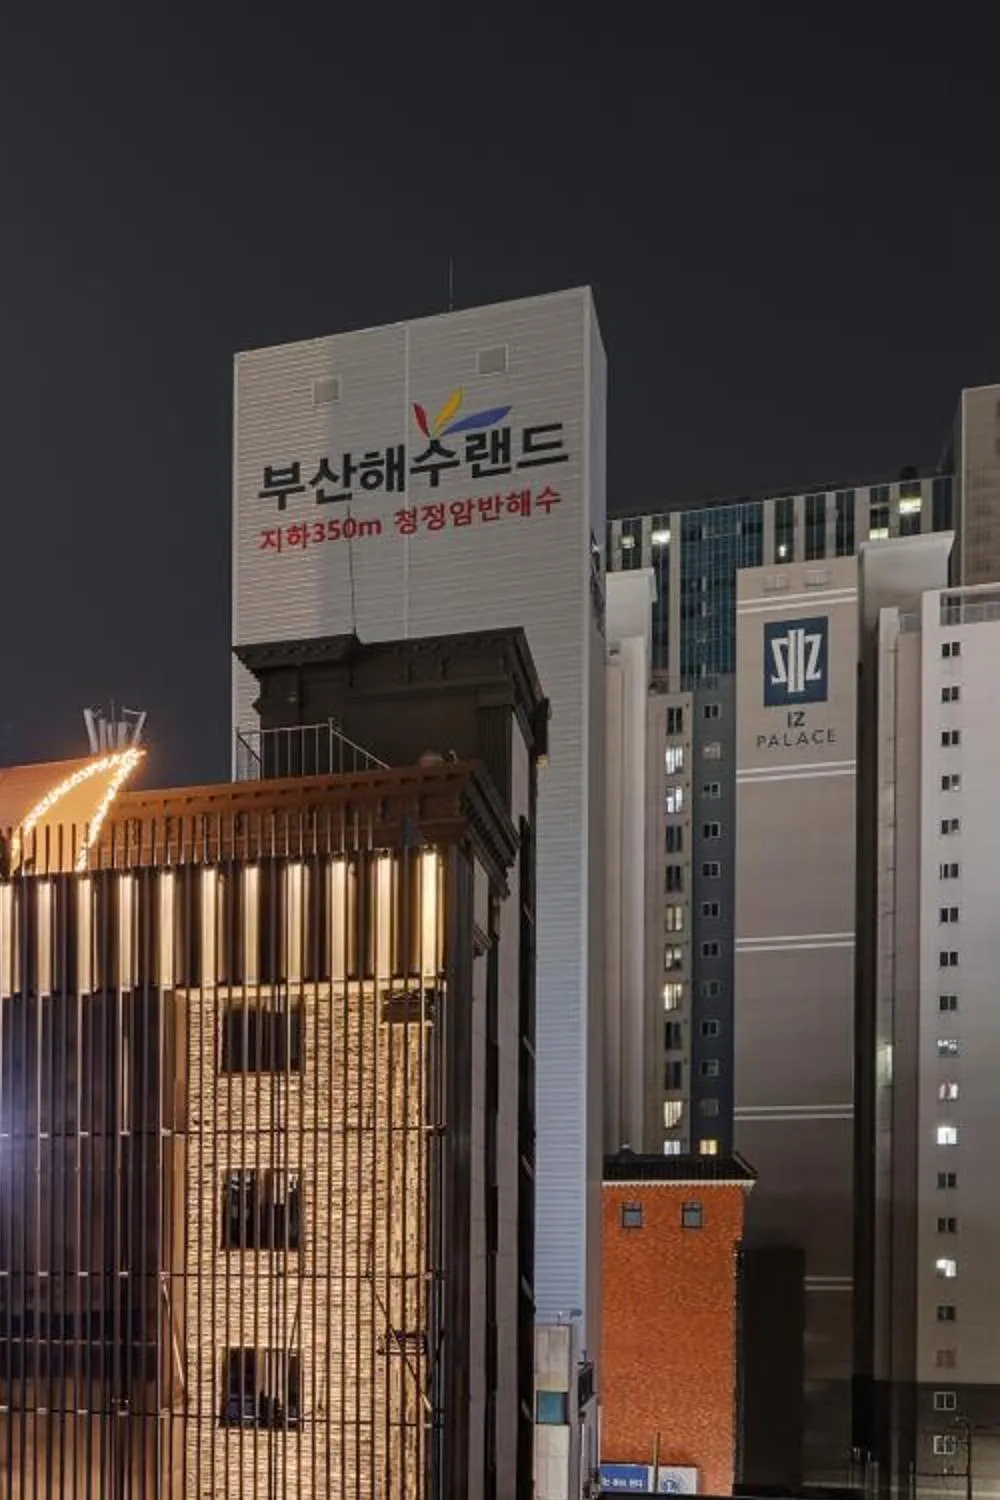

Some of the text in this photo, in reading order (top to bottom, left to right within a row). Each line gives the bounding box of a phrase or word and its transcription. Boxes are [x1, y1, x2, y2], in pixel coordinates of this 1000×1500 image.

[258, 423, 569, 510] 부산해수랜드
[260, 486, 561, 551] 지하350m 청정암반해수
[756, 728, 838, 748] PALACE
[787, 711, 806, 728] IZ
